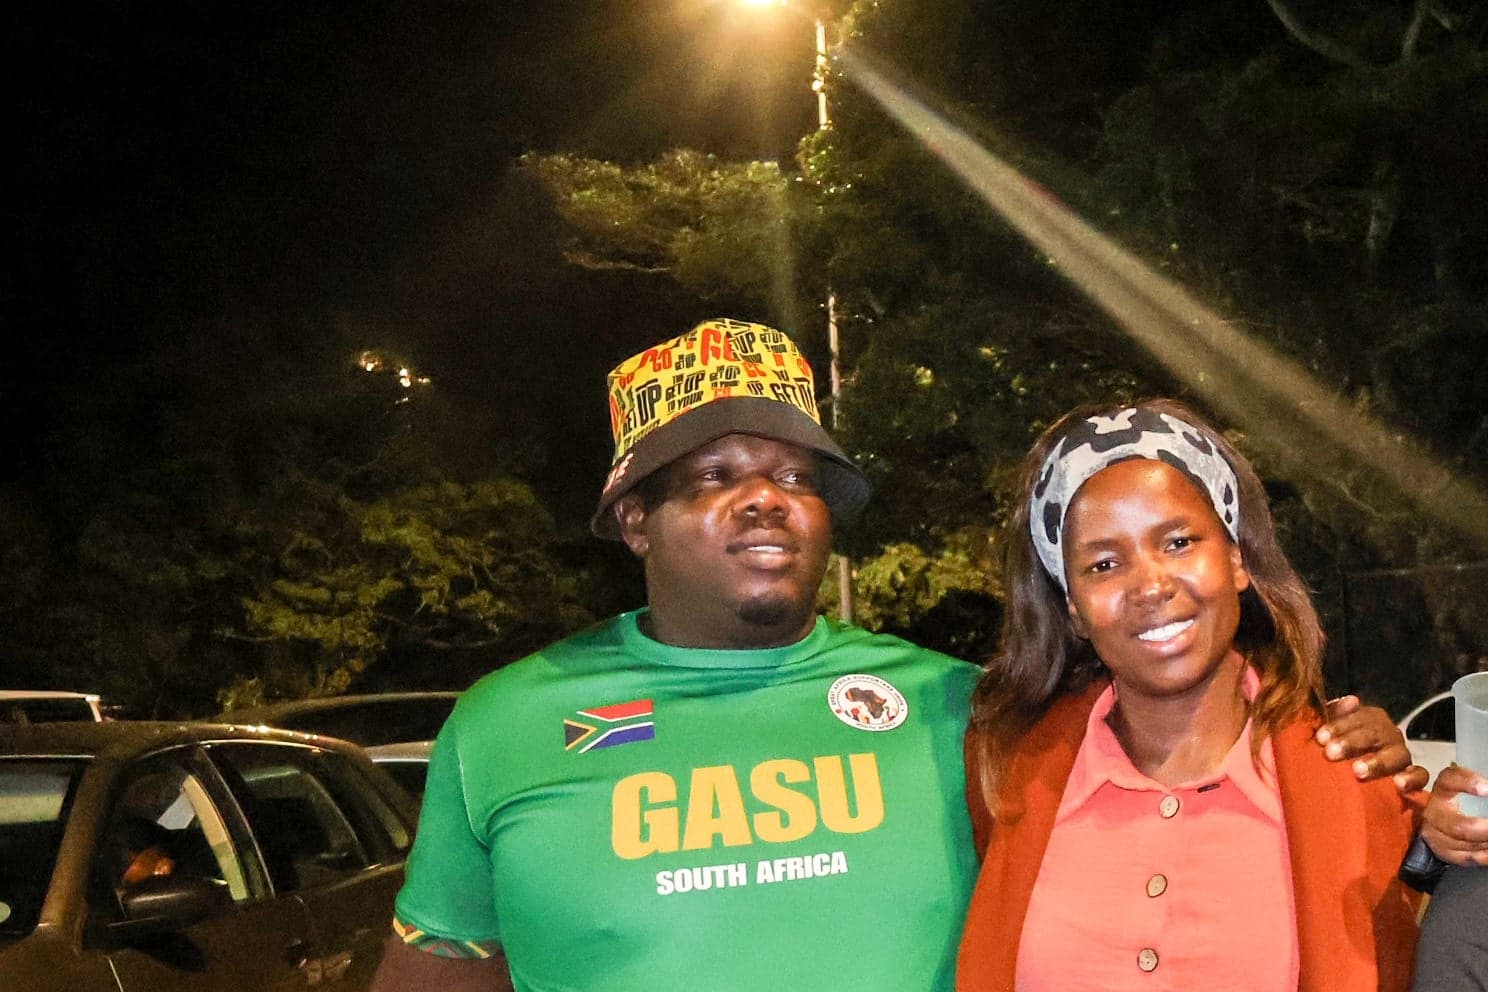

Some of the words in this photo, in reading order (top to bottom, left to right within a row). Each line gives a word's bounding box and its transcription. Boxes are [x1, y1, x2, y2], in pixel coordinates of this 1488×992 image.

[636, 378, 662, 426] UP
[684, 371, 705, 394] UP
[611, 753, 885, 860] GASU
[656, 862, 748, 895] SOUTH
[756, 851, 848, 884] AFRICA
